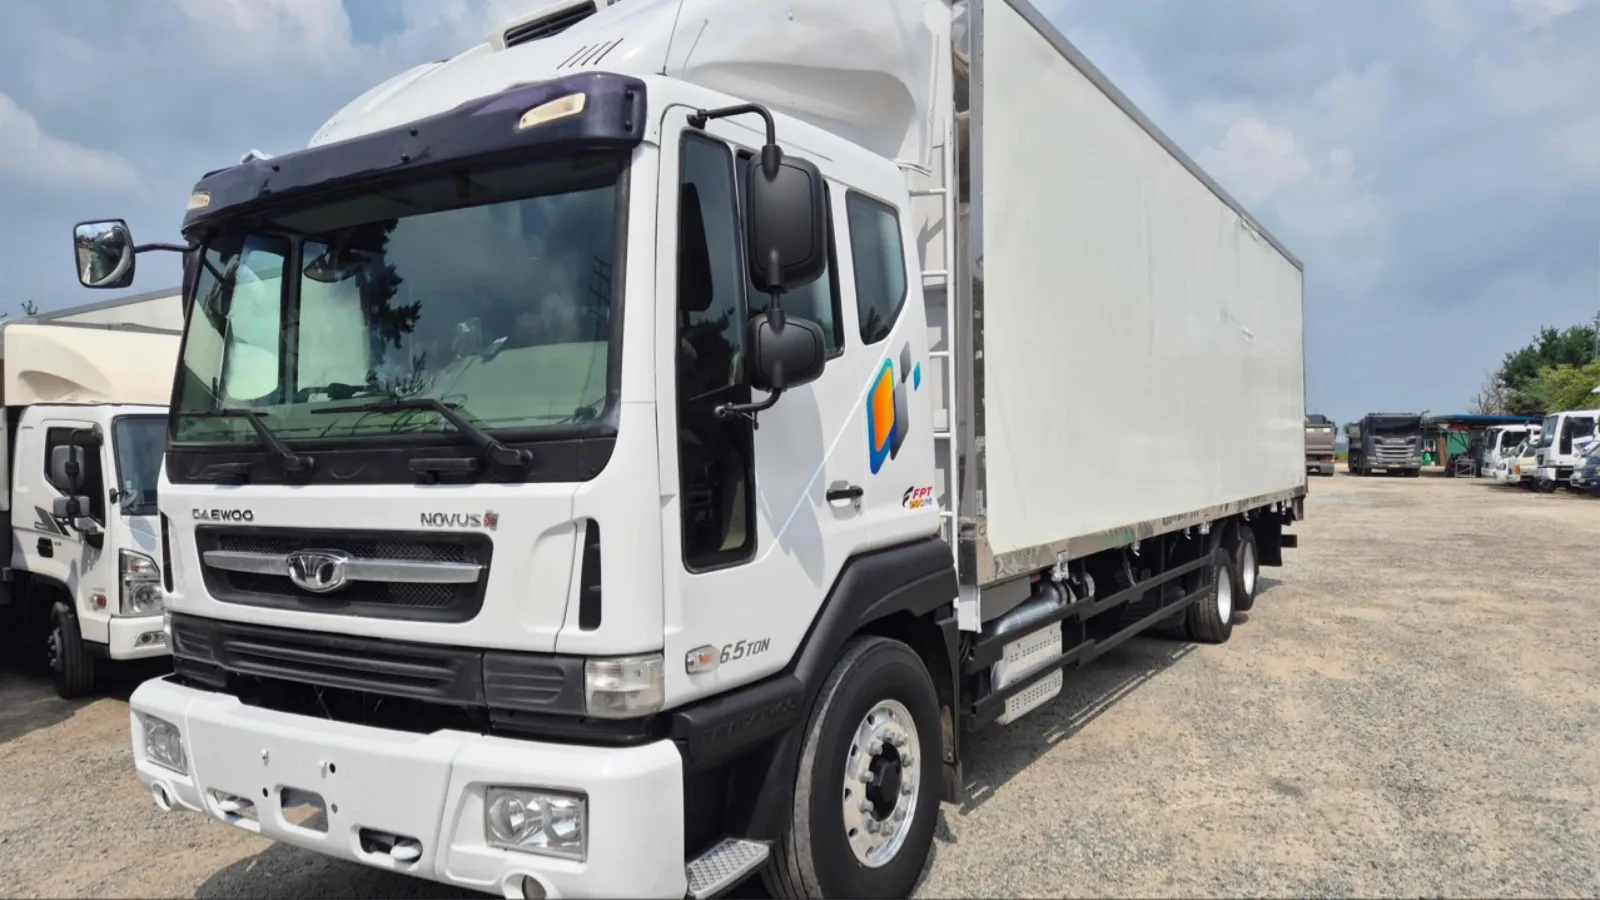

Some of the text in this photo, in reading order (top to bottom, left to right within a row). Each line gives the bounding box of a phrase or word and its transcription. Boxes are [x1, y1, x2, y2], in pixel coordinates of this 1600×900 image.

[912, 486, 933, 499] FPT
[192, 508, 254, 521] DAEWOO
[420, 512, 481, 528] NOVUS
